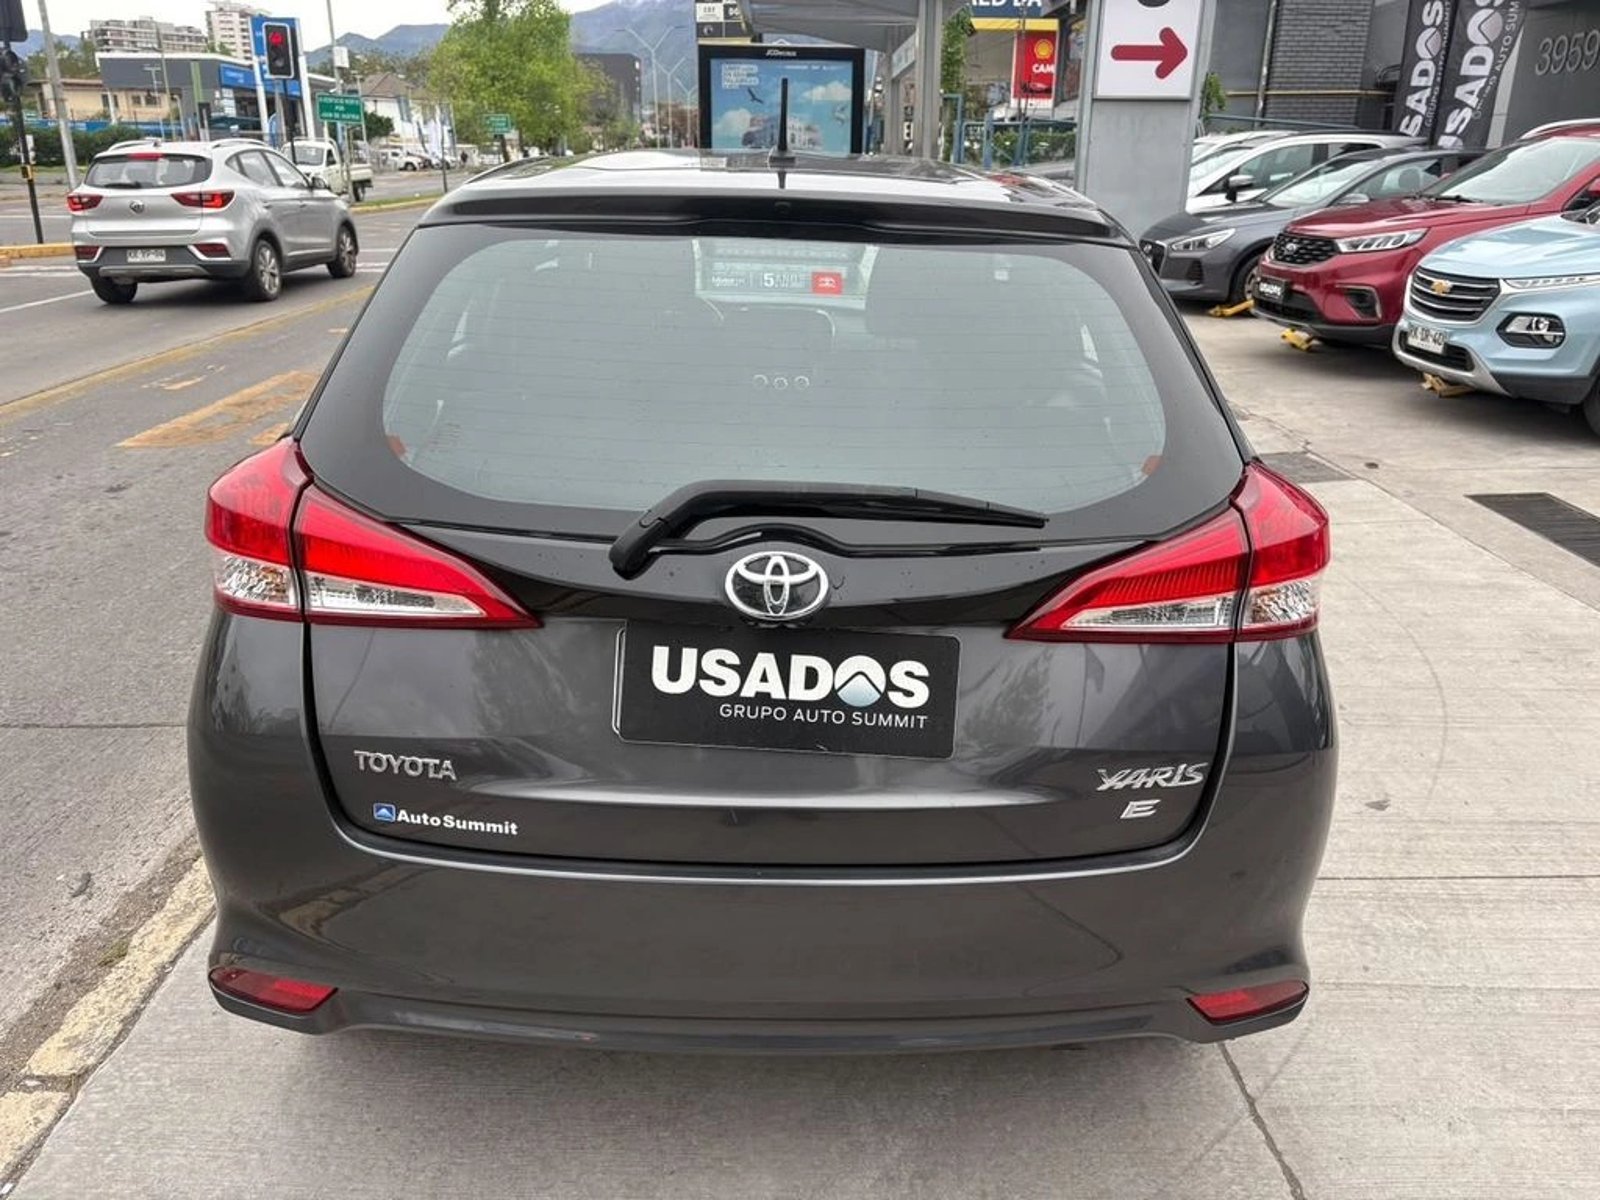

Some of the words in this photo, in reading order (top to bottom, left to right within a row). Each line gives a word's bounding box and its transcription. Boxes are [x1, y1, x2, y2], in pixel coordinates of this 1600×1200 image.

[1535, 29, 1600, 76] 3959
[652, 645, 931, 708] USADOS
[719, 703, 787, 721] GRUPO
[793, 709, 846, 725] AUTO
[851, 712, 929, 729] SUMMIT
[353, 750, 457, 781] TOYOTA
[1096, 762, 1209, 792] YARIS
[1120, 799, 1161, 819] E
